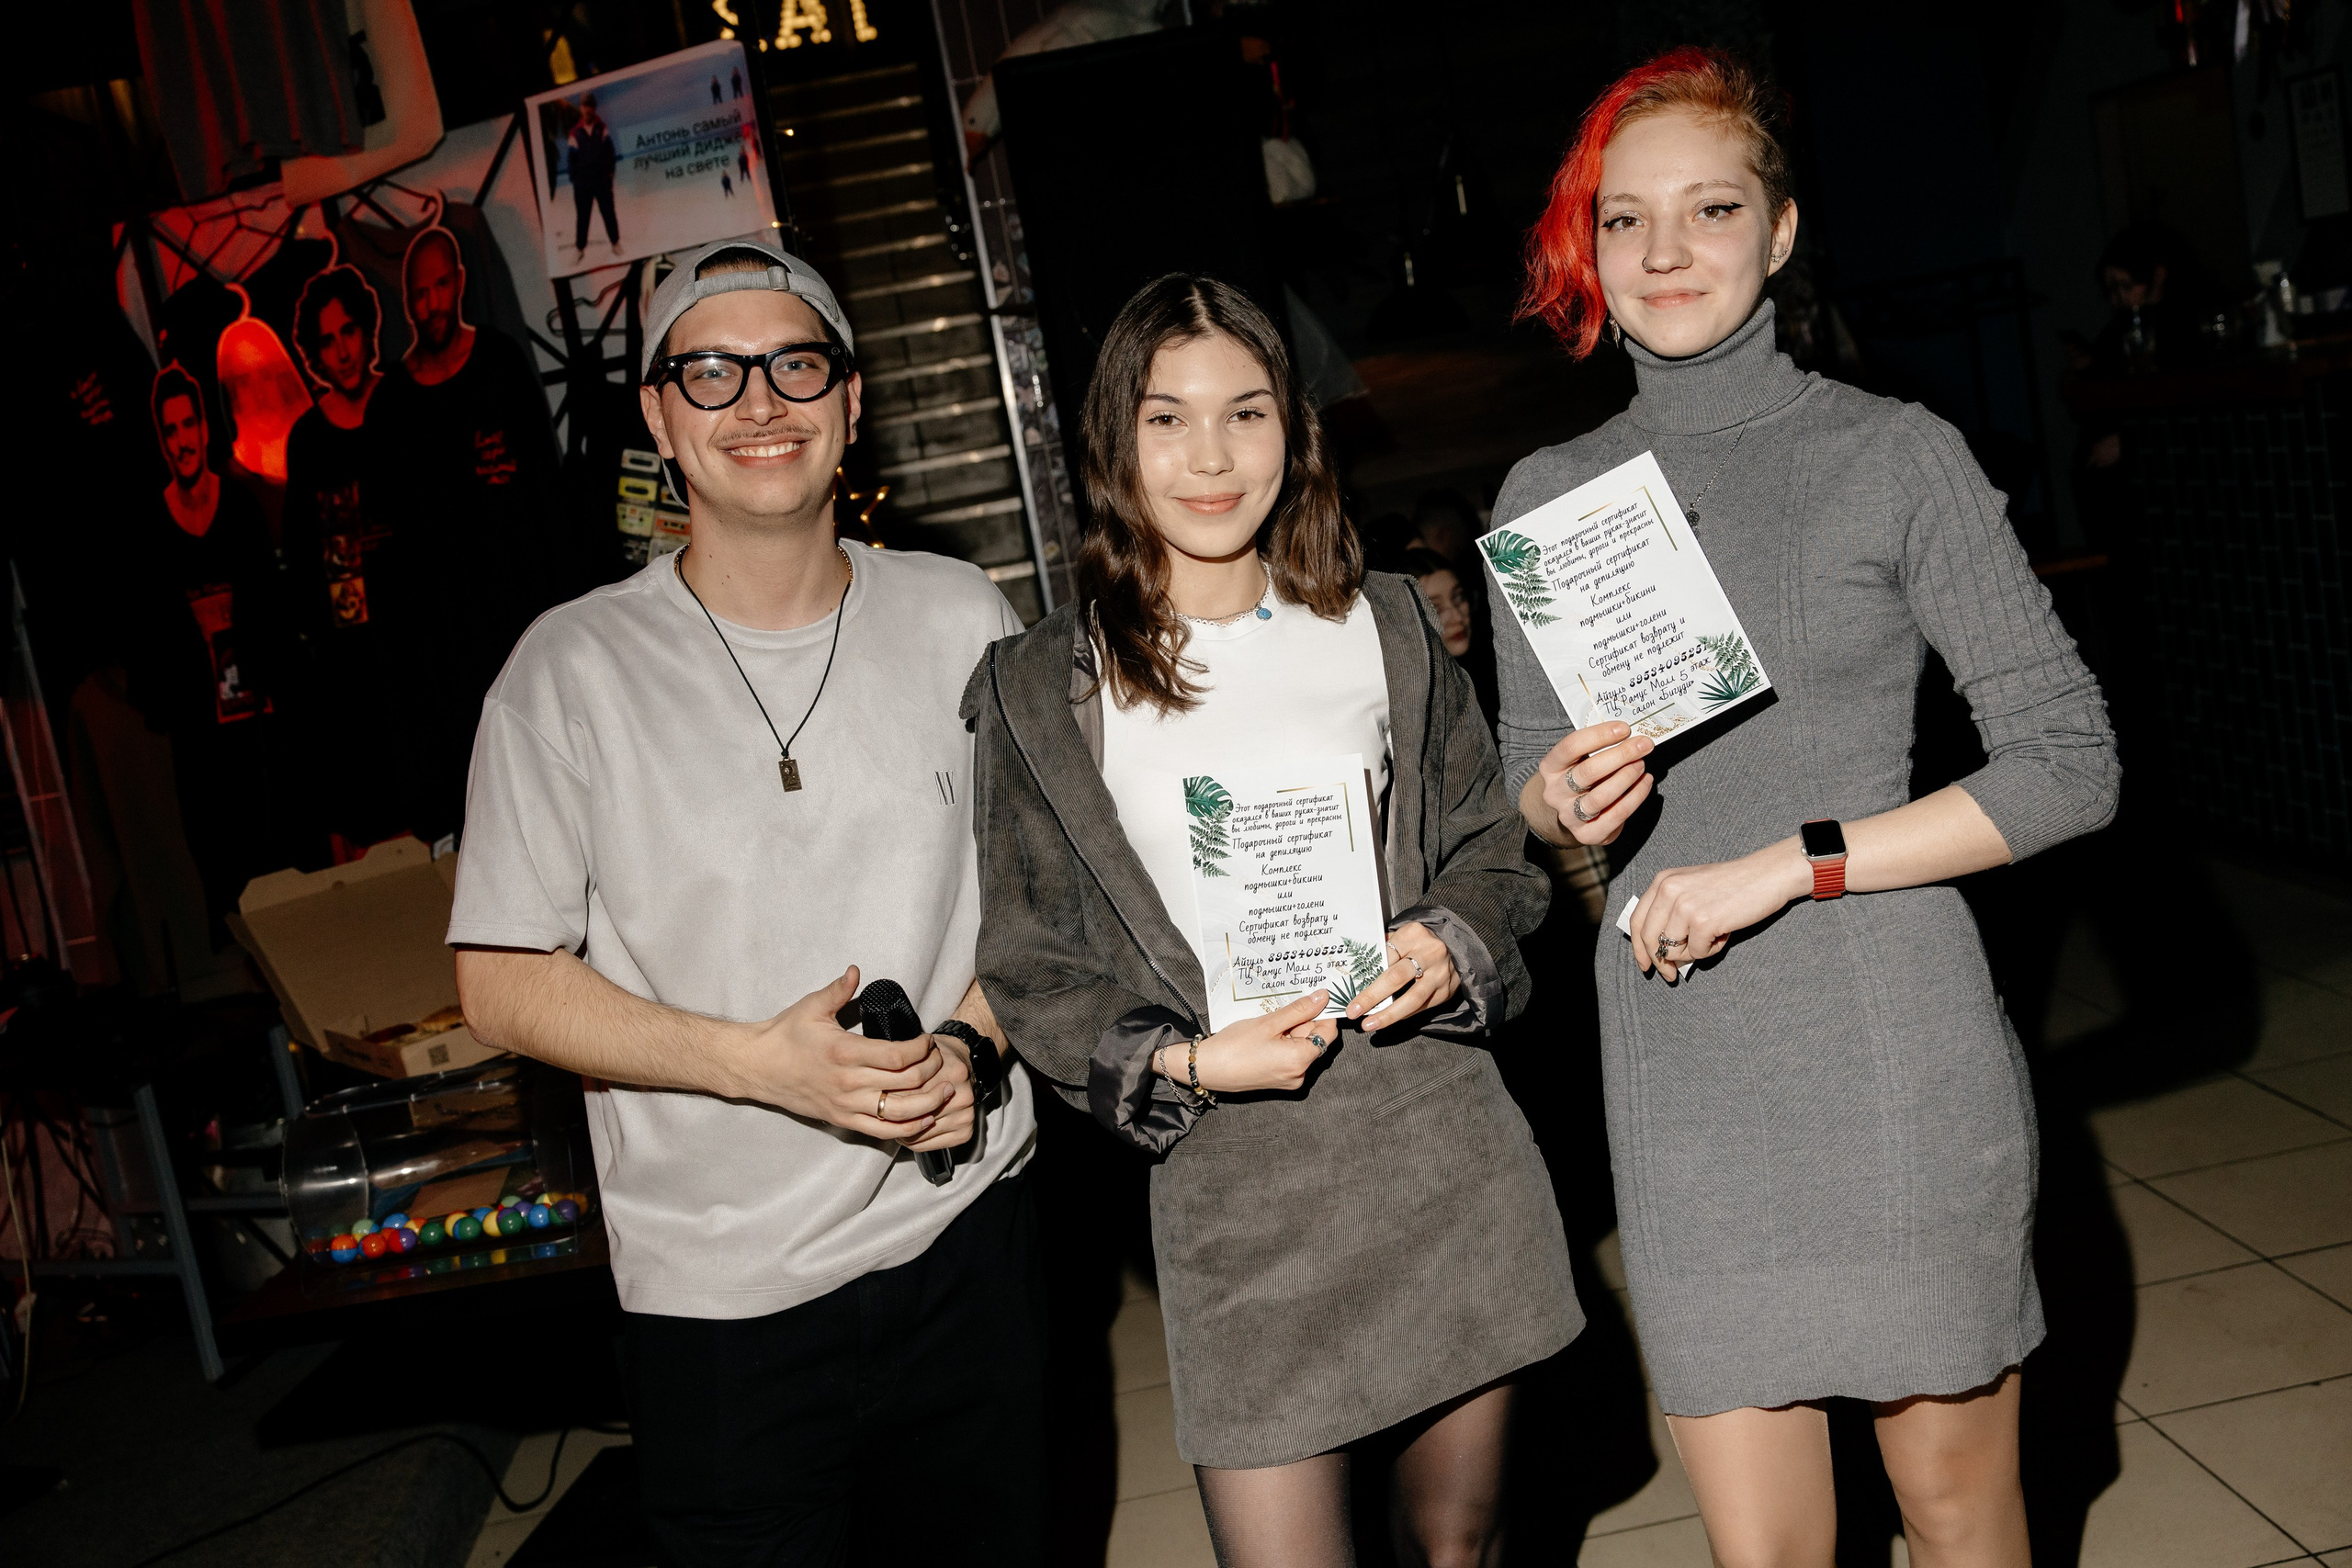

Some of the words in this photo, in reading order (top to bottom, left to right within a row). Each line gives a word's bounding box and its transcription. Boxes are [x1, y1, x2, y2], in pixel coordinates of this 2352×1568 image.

[636, 127, 691, 149] Антонь
[691, 108, 742, 134] самый
[633, 142, 691, 171] лучший
[665, 165, 684, 179] на
[686, 154, 730, 176] свете
[1543, 543, 1557, 556] Этот
[1561, 521, 1599, 547] подарочный
[1601, 502, 1637, 526] сертификат
[1544, 547, 1573, 567] оказался
[1574, 541, 1579, 551] в
[1580, 534, 1601, 547] ваших
[1546, 567, 1556, 577] вы
[1556, 553, 1587, 571] любимы,
[1589, 541, 1610, 558] дороги
[1619, 518, 1654, 542] прекрасны
[1552, 559, 1602, 592] Подарочный
[1606, 537, 1649, 566] сертификат
[1580, 582, 1590, 593] на
[1594, 559, 1635, 590] депиляцию
[1590, 581, 1632, 607] Комплекс
[1616, 611, 1632, 625] или
[1589, 640, 1637, 669] Сертификат
[1640, 621, 1677, 644] возврату
[1679, 616, 1686, 625] и
[1602, 659, 1631, 678] обмену
[1634, 651, 1644, 662] не
[1647, 631, 1684, 656] подлежит
[1596, 685, 1626, 705] Айгуль
[1603, 695, 1623, 717] ТЦ
[1621, 688, 1648, 706] Рамус
[1650, 675, 1676, 692] Молл
[1680, 669, 1689, 682] 5
[1690, 656, 1712, 672] этаж
[1633, 698, 1656, 716] салон
[1235, 802, 1250, 814] Этот
[1253, 798, 1293, 812] подарочный
[1295, 795, 1333, 808] сертификат
[1231, 823, 1240, 834] вы
[1242, 821, 1272, 833] любимы,
[1274, 819, 1296, 832] дороги
[1306, 814, 1342, 825] прекрасны
[1232, 814, 1262, 826] оказался
[1264, 809, 1269, 820] в
[1271, 808, 1292, 819] ваших
[1232, 834, 1283, 852] Подарочный
[1286, 829, 1332, 846] сертификат
[1255, 851, 1265, 860] на
[1269, 845, 1313, 862] депиляцию
[1261, 863, 1302, 876] Комплекс
[1276, 890, 1293, 900] или
[1238, 919, 1289, 934] Сертификат
[1293, 911, 1329, 928] возврату
[1332, 913, 1338, 921] и
[1247, 930, 1276, 945] обмену
[1280, 931, 1290, 941] не
[1294, 926, 1332, 941] подлежит
[1231, 955, 1264, 969] Айгуль
[1238, 964, 1253, 987] ТЦ
[1256, 964, 1282, 978] Рамус
[1285, 961, 1311, 975] Молл
[1314, 962, 1323, 975] 5
[1327, 959, 1348, 970] этаж
[1261, 979, 1285, 990] салон
